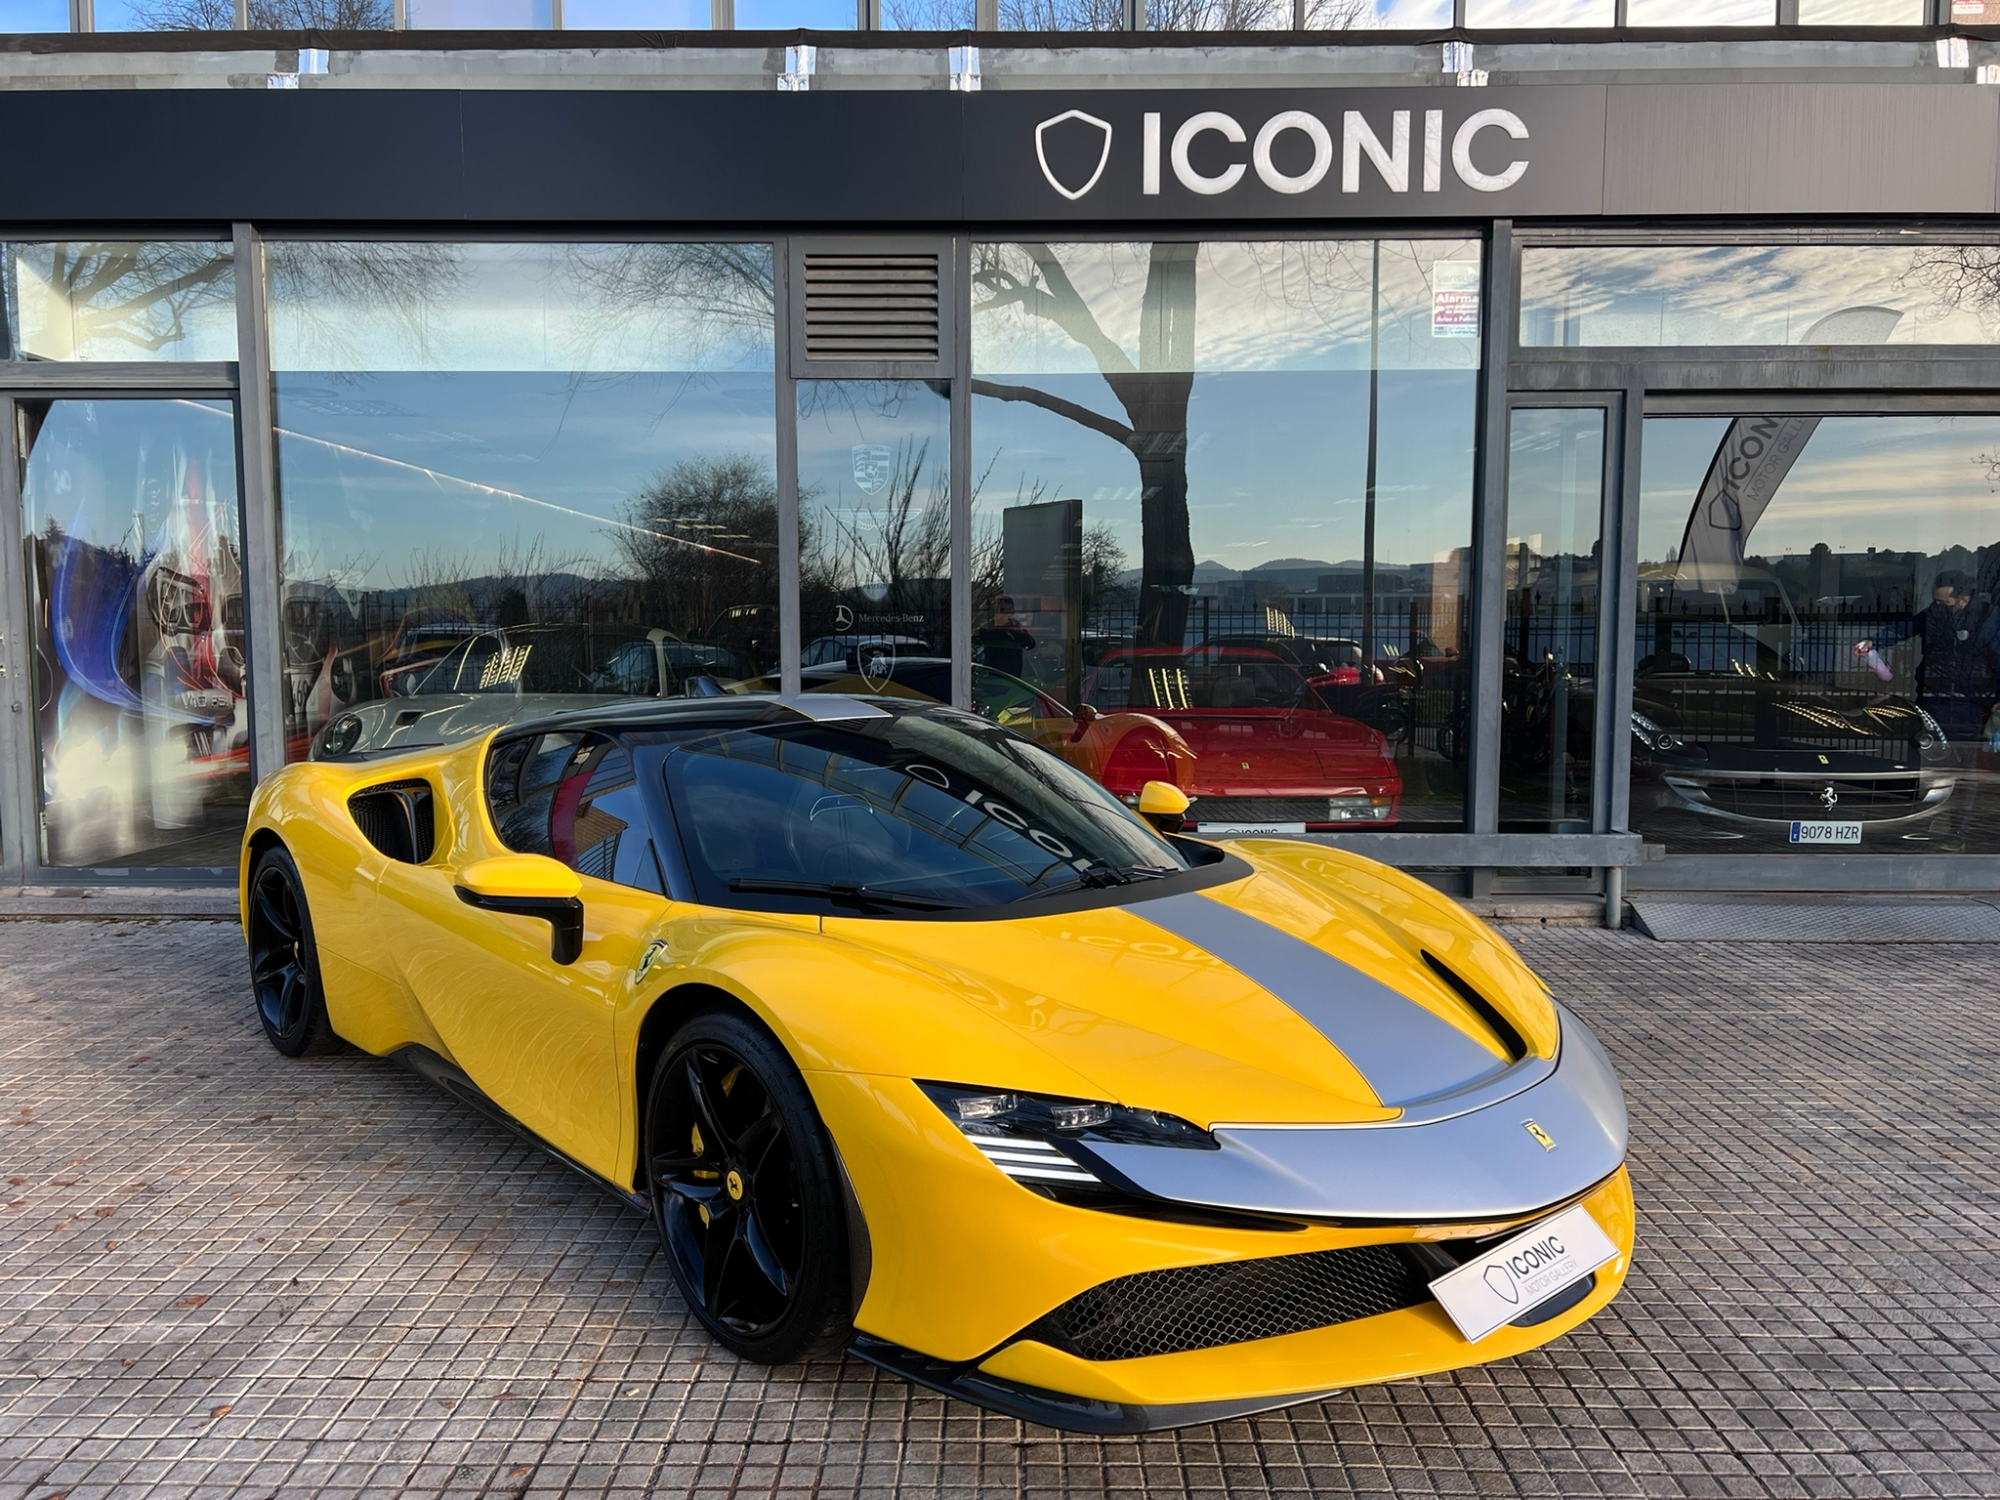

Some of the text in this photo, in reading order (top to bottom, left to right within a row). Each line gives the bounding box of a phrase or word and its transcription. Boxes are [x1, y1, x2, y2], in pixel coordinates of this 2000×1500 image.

[1143, 108, 1530, 194] ICONIC
[1435, 293, 1478, 303] Alarma
[1747, 454, 1782, 500] MOTOR
[858, 613, 924, 624] Mercedes-Benz
[1801, 826, 1832, 839] 9078
[1836, 826, 1859, 839] HZR
[1506, 1235, 1565, 1279] ICONIC
[1525, 1259, 1579, 1296] MOTOR GALLERY
